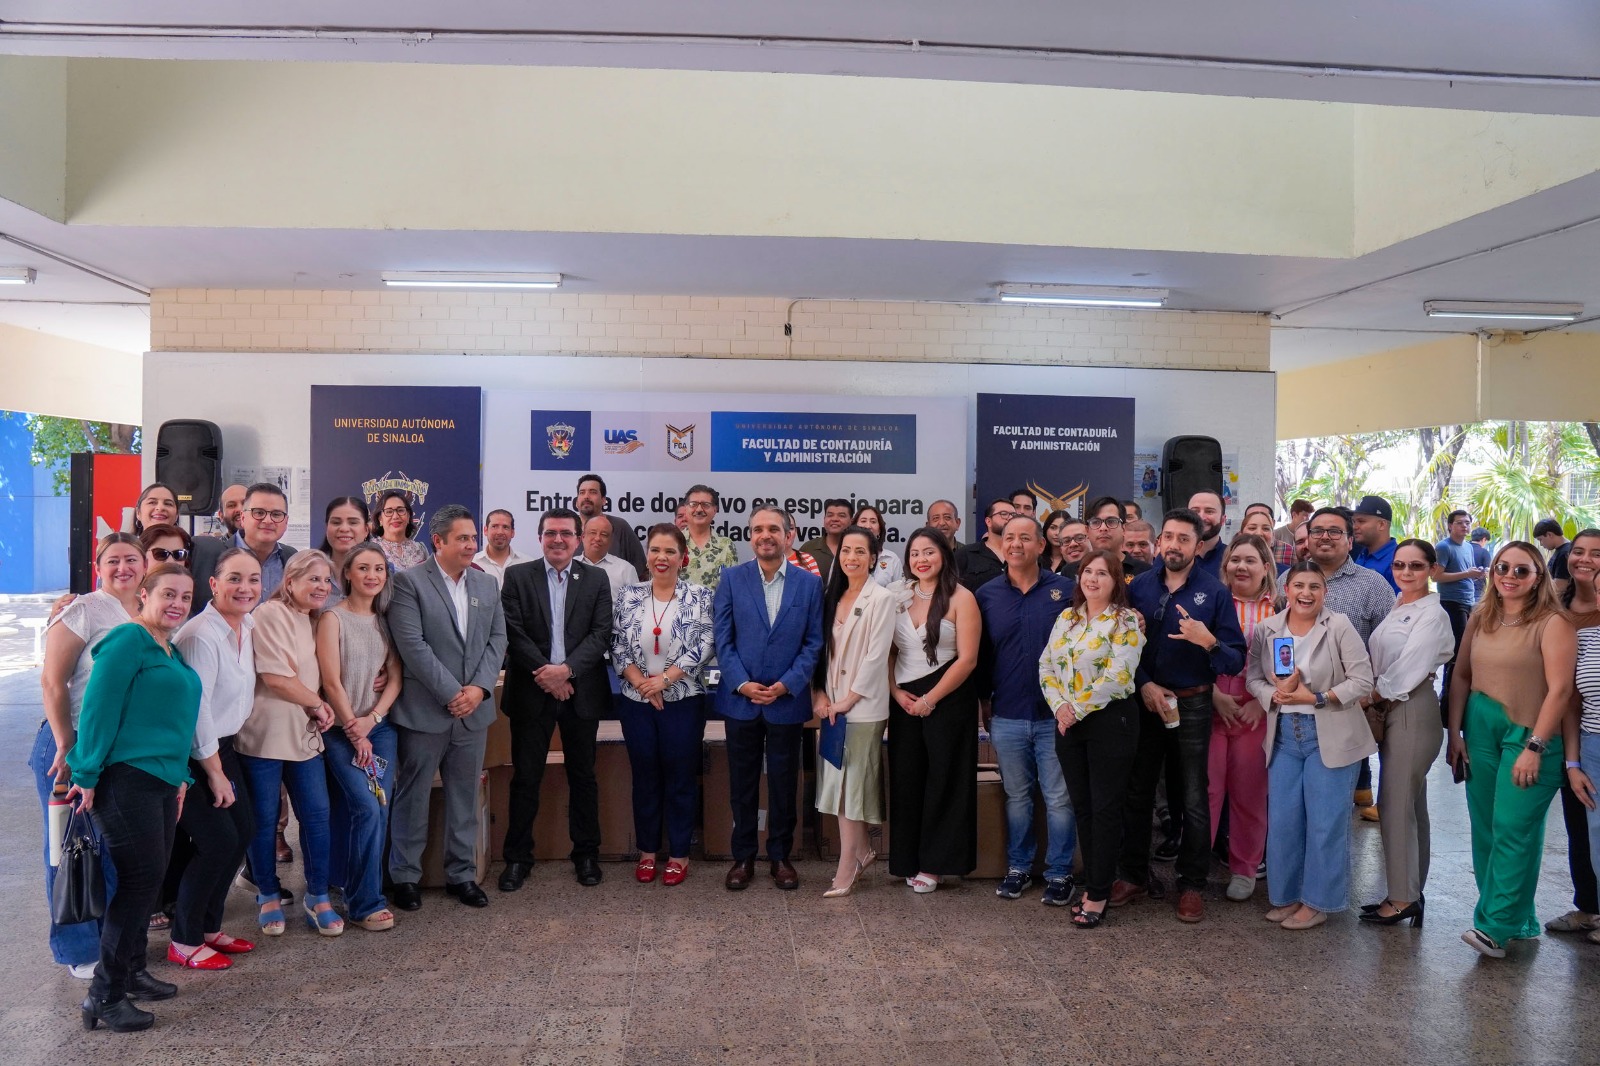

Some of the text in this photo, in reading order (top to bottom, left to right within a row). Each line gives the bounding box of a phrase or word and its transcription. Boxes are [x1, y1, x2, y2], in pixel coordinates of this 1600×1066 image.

[334, 417, 455, 429] UNIVERSIDAD AUTÓNOMA
[367, 433, 425, 443] DE SINALOA
[604, 429, 638, 444] UAS
[993, 425, 1118, 438] FACULTAD DE CONTADURÍA
[742, 437, 893, 451] FACULTAD DE CONTADURÍA
[1011, 440, 1100, 452] Y ADMINISTRACIÓN
[763, 450, 872, 464] Y ADMINISTRACIÓN
[526, 490, 612, 513] Entra
[618, 491, 645, 513] de
[875, 498, 924, 516] para
